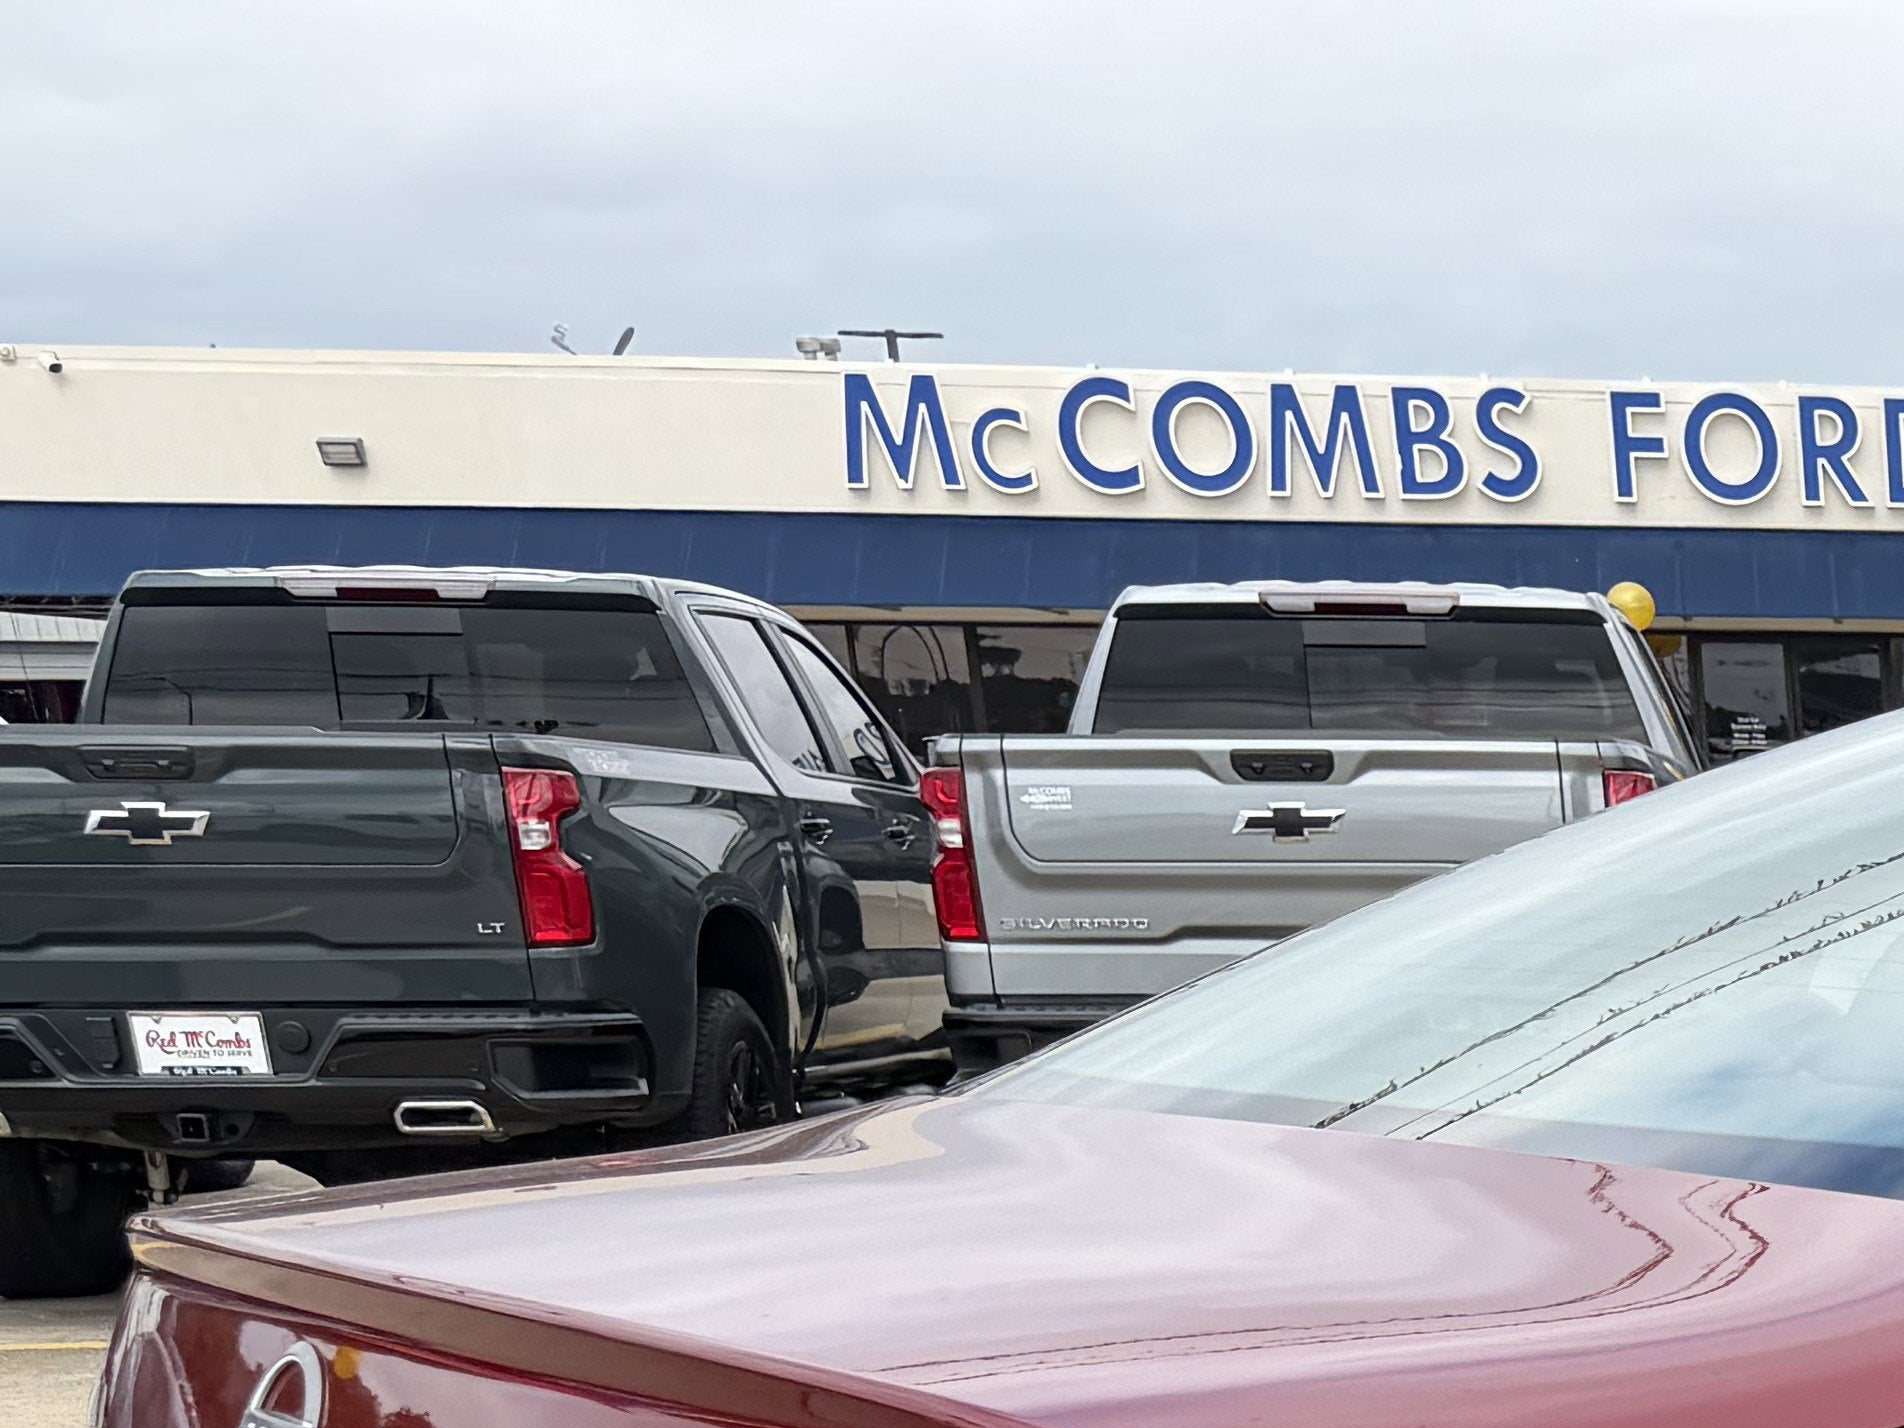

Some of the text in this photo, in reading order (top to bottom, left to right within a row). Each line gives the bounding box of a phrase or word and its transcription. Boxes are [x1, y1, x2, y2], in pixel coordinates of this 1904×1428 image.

[842, 372, 1543, 502] McCOMBS
[477, 922, 505, 933] LT
[1000, 917, 1148, 929] SILVERADO
[145, 1029, 252, 1054] Red McCombs
[213, 1049, 225, 1057] TO
